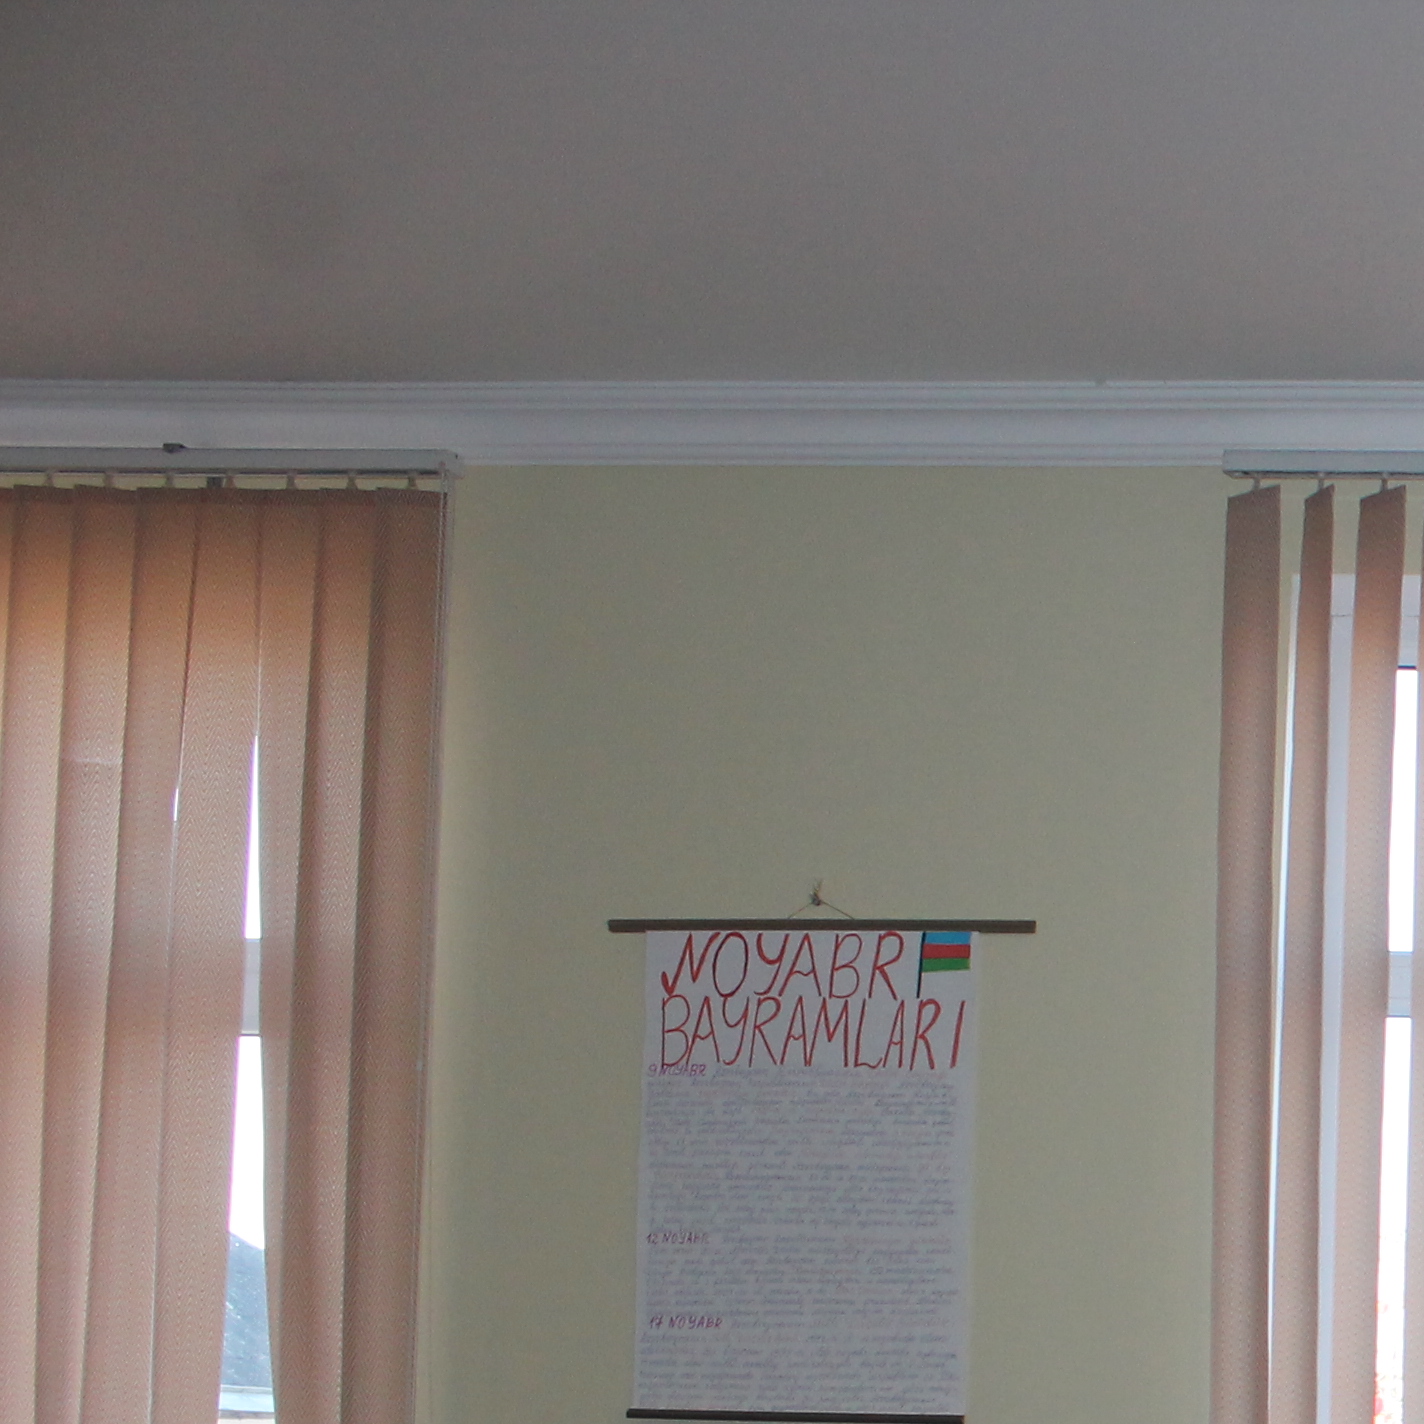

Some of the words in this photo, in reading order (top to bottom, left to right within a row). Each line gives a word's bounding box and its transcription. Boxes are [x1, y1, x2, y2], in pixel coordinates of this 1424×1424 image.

[661, 931, 905, 1000] NOYABR
[660, 994, 966, 1070] BAYRAMLARI
[648, 1063, 657, 1077] 9
[646, 1233, 658, 1245] 12
[650, 1315, 664, 1329] 17
[668, 1315, 722, 1329] NOYABR
